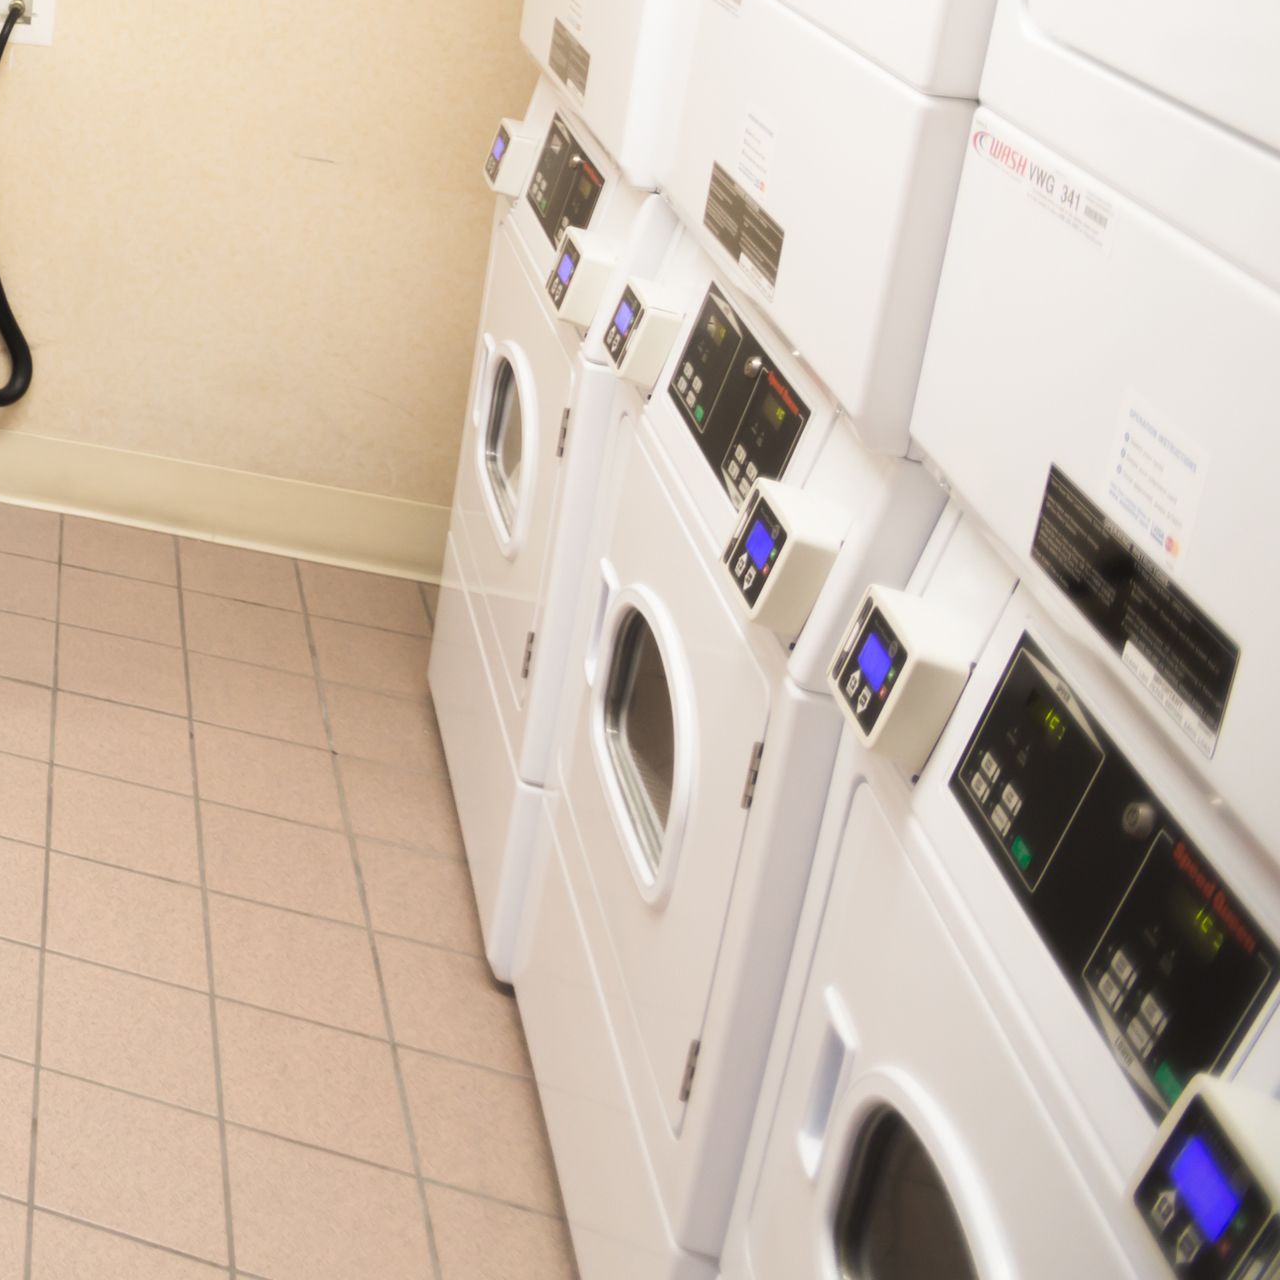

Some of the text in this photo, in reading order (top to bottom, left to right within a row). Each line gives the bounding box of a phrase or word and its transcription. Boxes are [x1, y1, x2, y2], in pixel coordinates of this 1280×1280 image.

[989, 137, 1080, 211] WASH VWG 341
